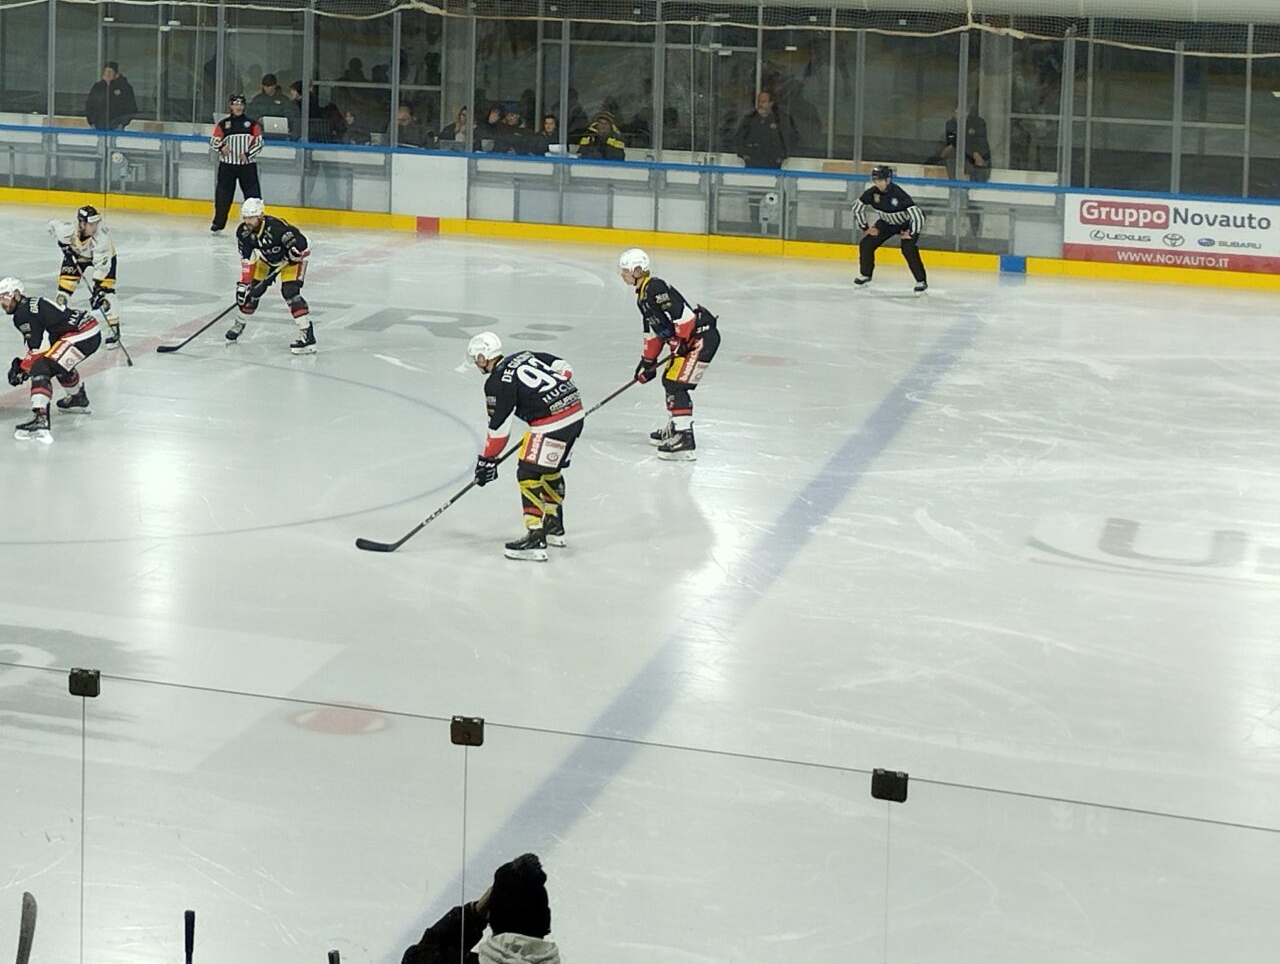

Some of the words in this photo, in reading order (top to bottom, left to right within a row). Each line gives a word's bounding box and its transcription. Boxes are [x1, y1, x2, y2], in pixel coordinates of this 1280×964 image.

[1081, 201, 1167, 227] Gruppo
[1173, 207, 1271, 230] Novauto
[1106, 233, 1151, 242] LEXUS
[1218, 240, 1262, 249] SUBARU
[1117, 251, 1229, 268] WWW.NOVAUTO.IT
